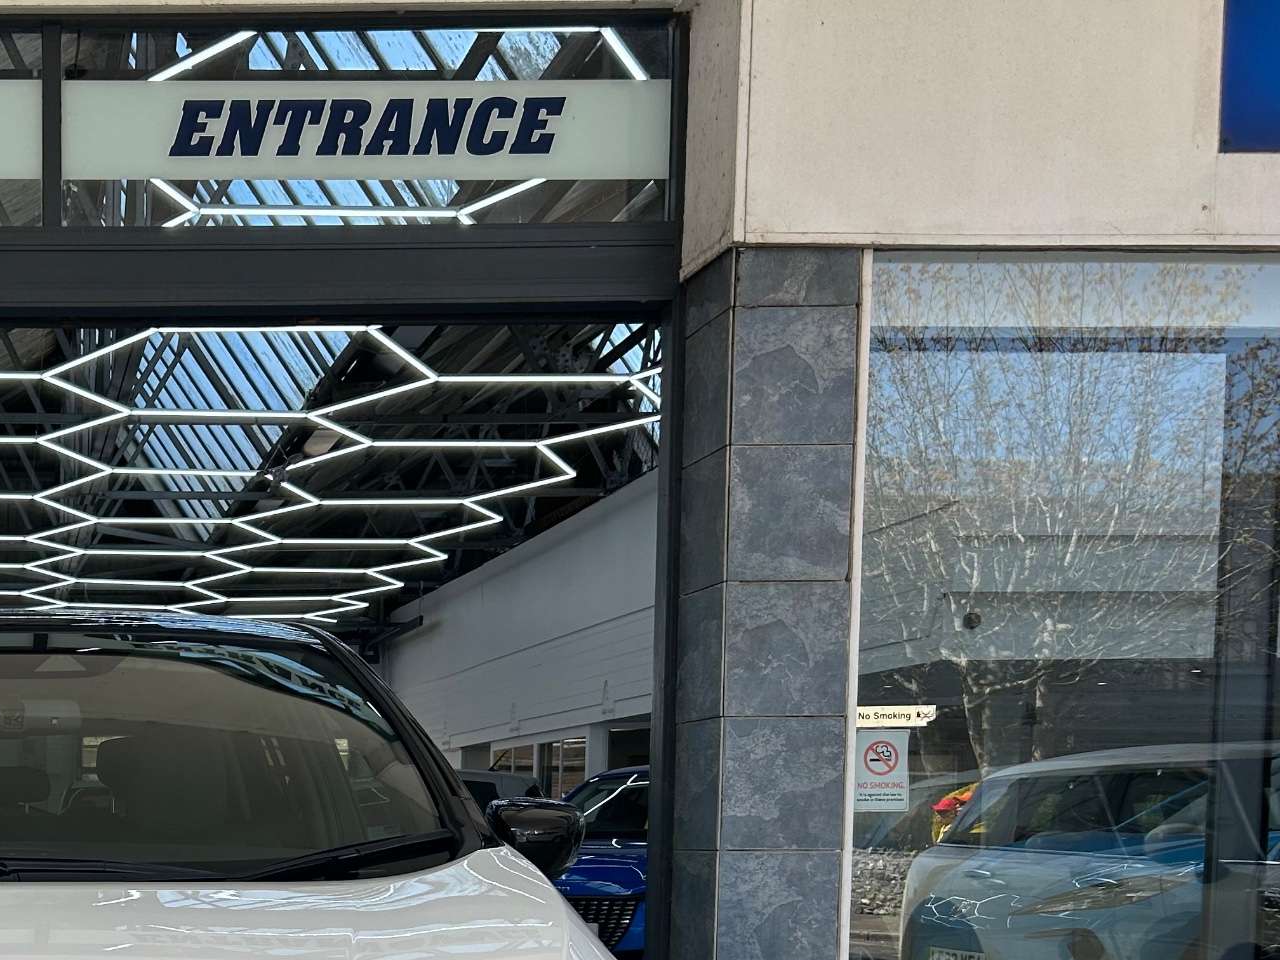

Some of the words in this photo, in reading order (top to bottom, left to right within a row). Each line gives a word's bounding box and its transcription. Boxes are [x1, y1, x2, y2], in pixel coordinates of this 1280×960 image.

[168, 96, 567, 157] ENTRANCE
[858, 712, 871, 720] No
[873, 711, 911, 721] Smoking
